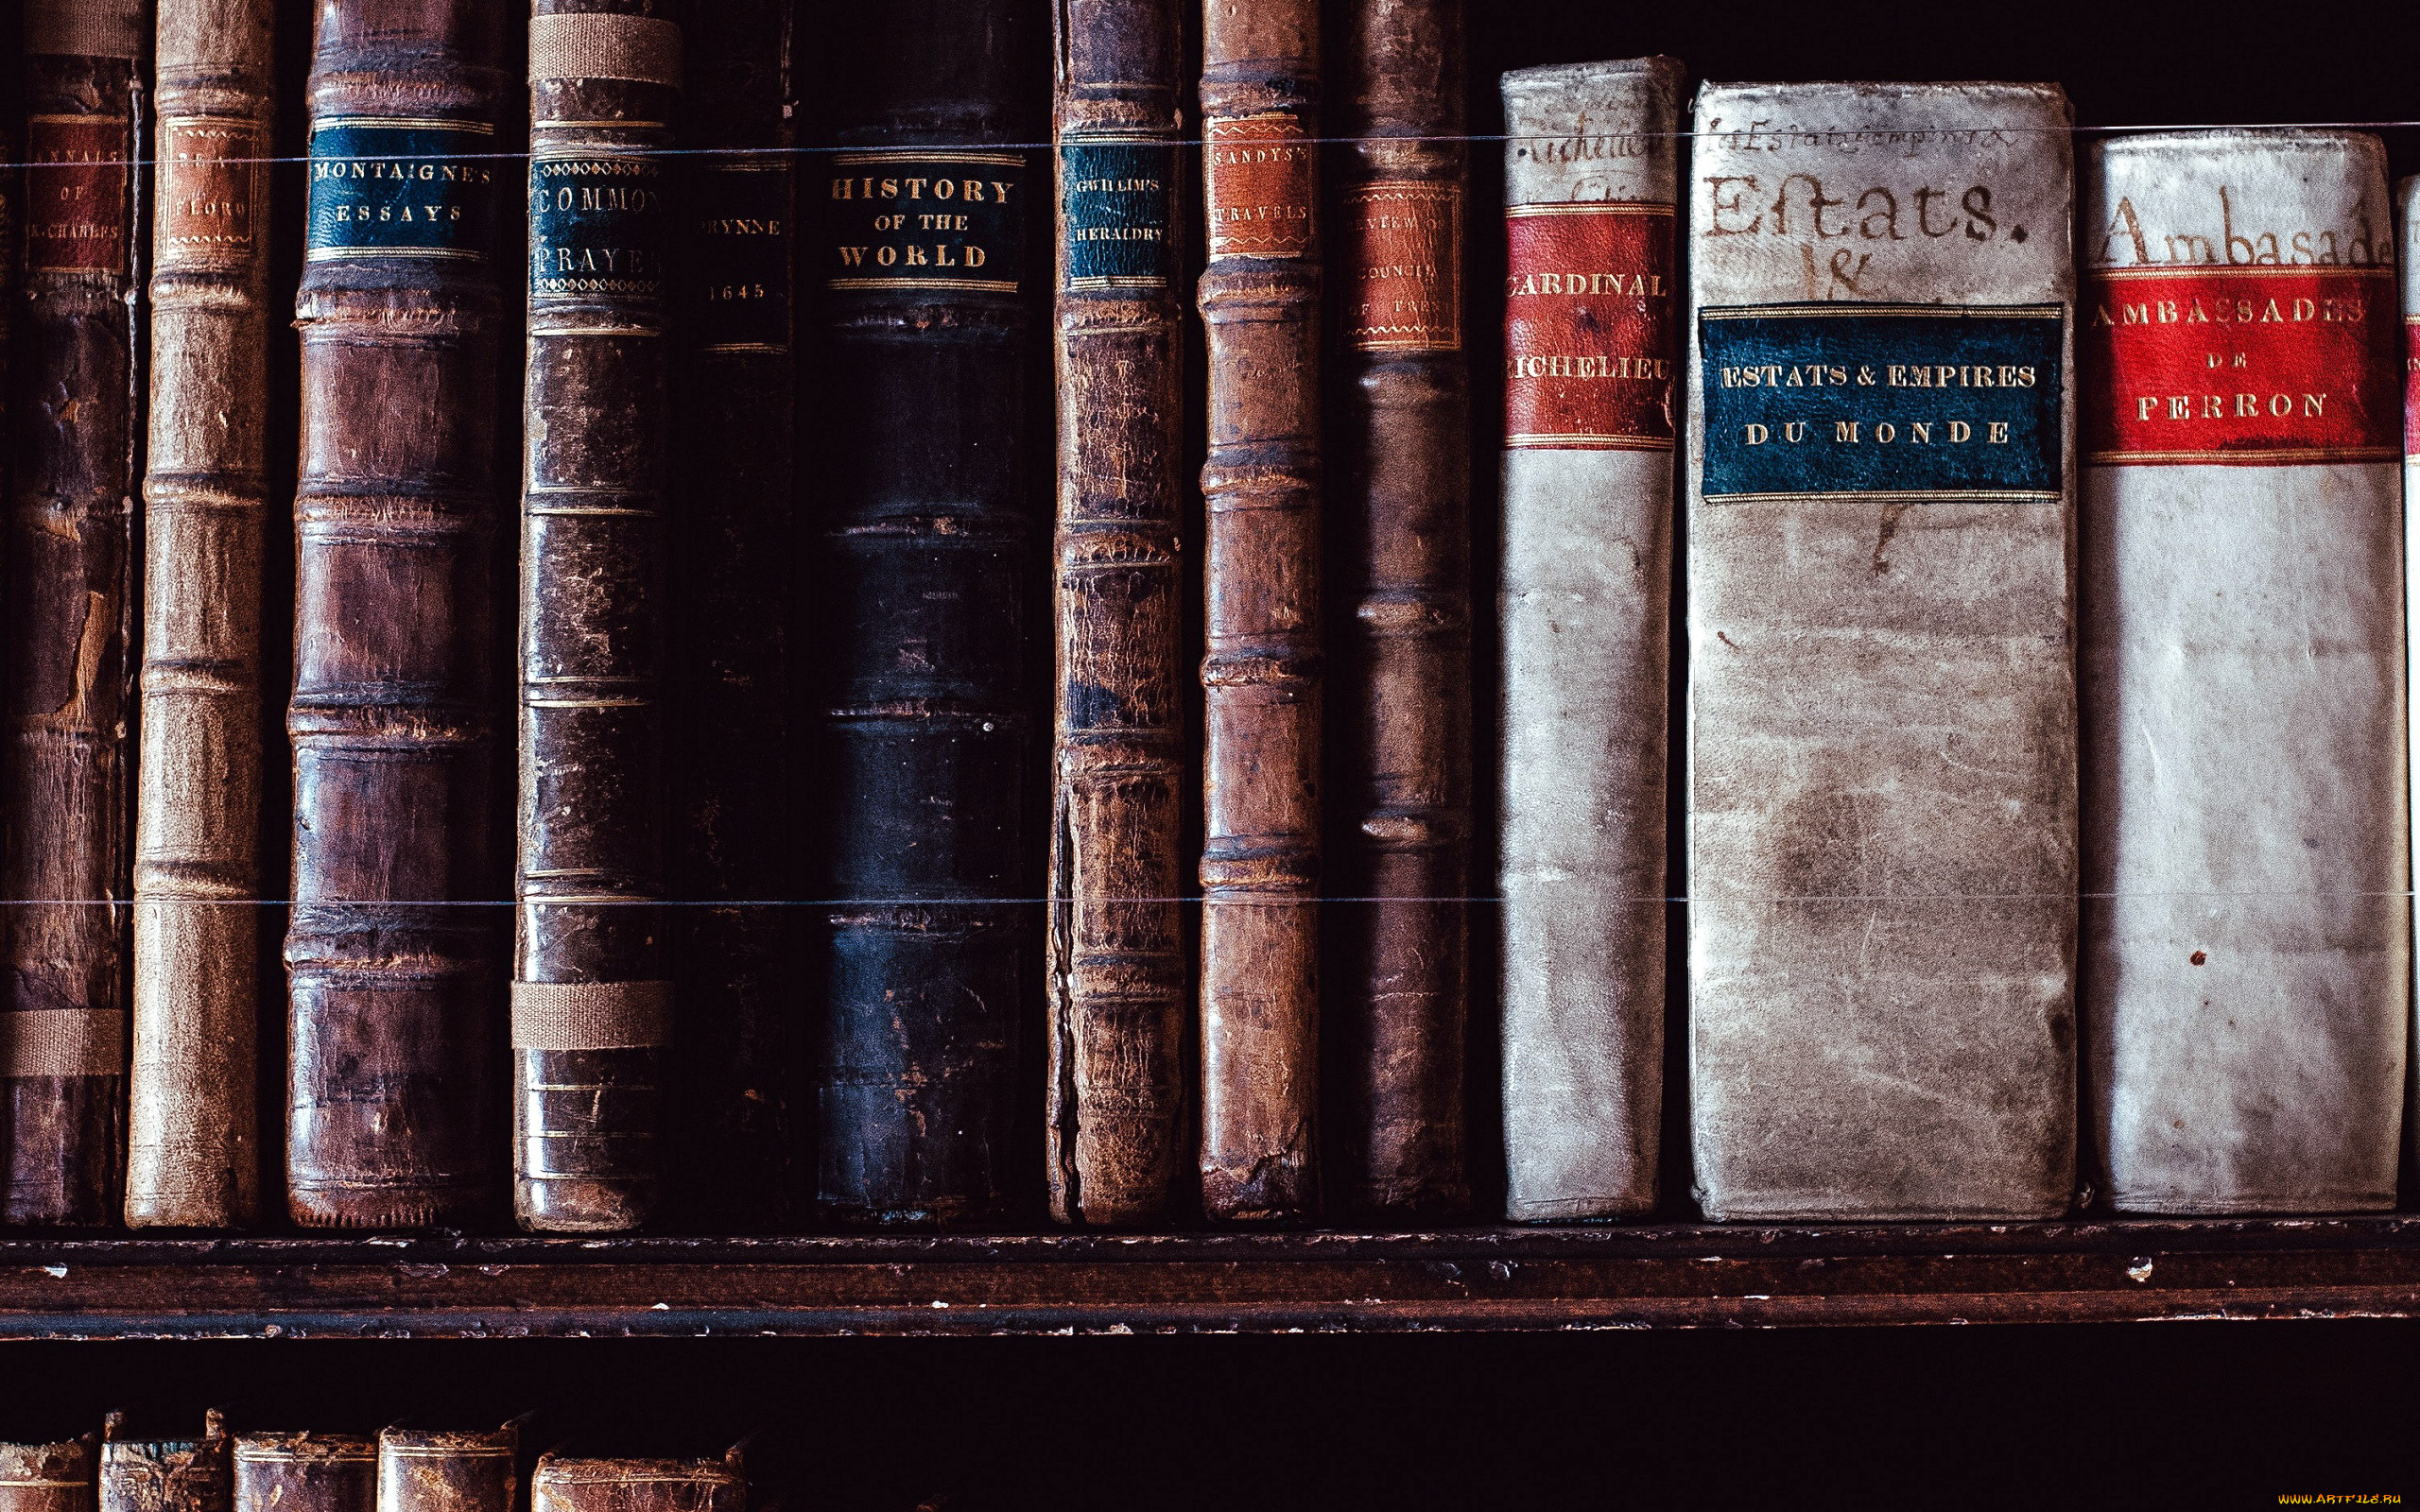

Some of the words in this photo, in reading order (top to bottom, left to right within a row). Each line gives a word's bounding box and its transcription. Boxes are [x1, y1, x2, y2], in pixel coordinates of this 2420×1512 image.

[60, 186, 87, 200] OF
[831, 178, 1014, 204] HISTORY
[337, 205, 460, 222] ESSAYS
[1216, 205, 1306, 222] TRAVELS
[874, 215, 906, 231] OF
[918, 215, 968, 231] THE
[1077, 227, 1163, 242] HERALDRY
[838, 245, 986, 267] WORLD
[710, 284, 764, 301] 1645
[1504, 272, 1667, 298] CARDINAL
[2206, 351, 2247, 369] DE
[1720, 365, 1847, 388] ESTATS
[1857, 366, 1876, 386] &
[1887, 364, 2035, 387] EMPIRES
[2135, 393, 2326, 421] PERRON
[1745, 421, 1806, 445] DU
[1834, 421, 2009, 444] MONDE
